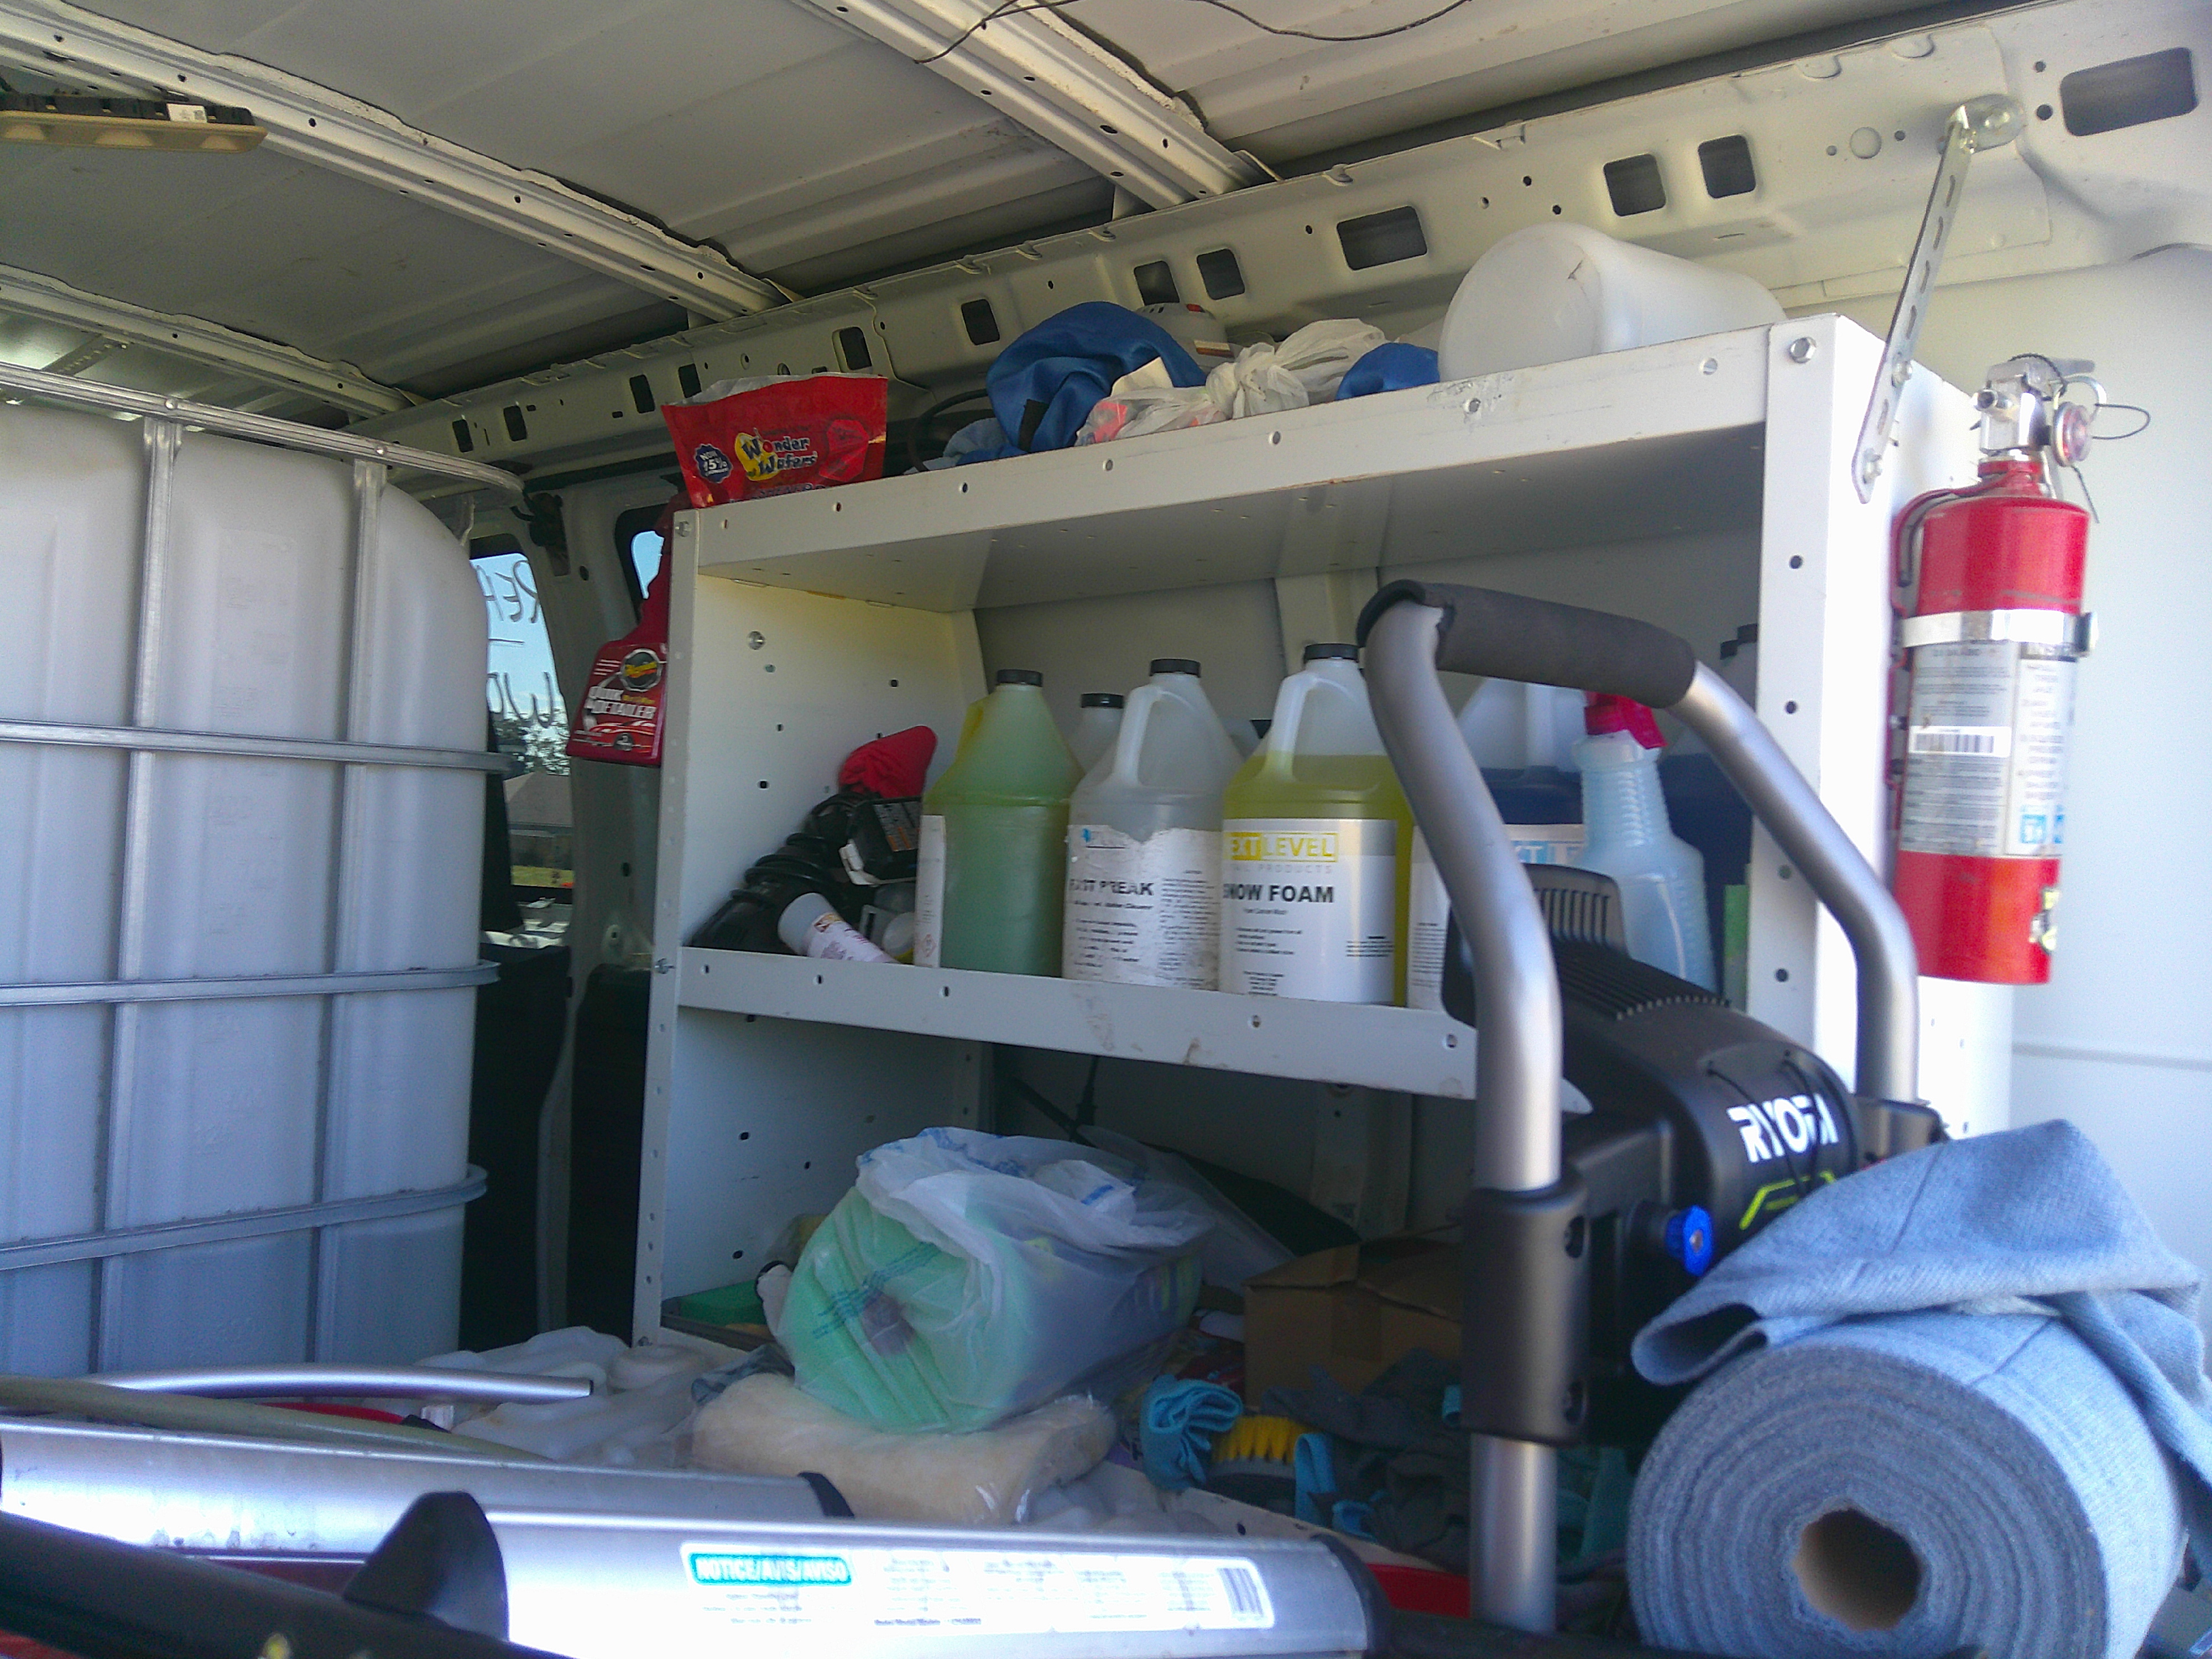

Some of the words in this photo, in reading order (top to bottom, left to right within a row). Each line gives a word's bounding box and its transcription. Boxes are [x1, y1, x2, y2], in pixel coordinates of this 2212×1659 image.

[758, 452, 817, 475] Wafers
[1262, 837, 1333, 857] LEVEL
[1269, 885, 1334, 903] FOAM
